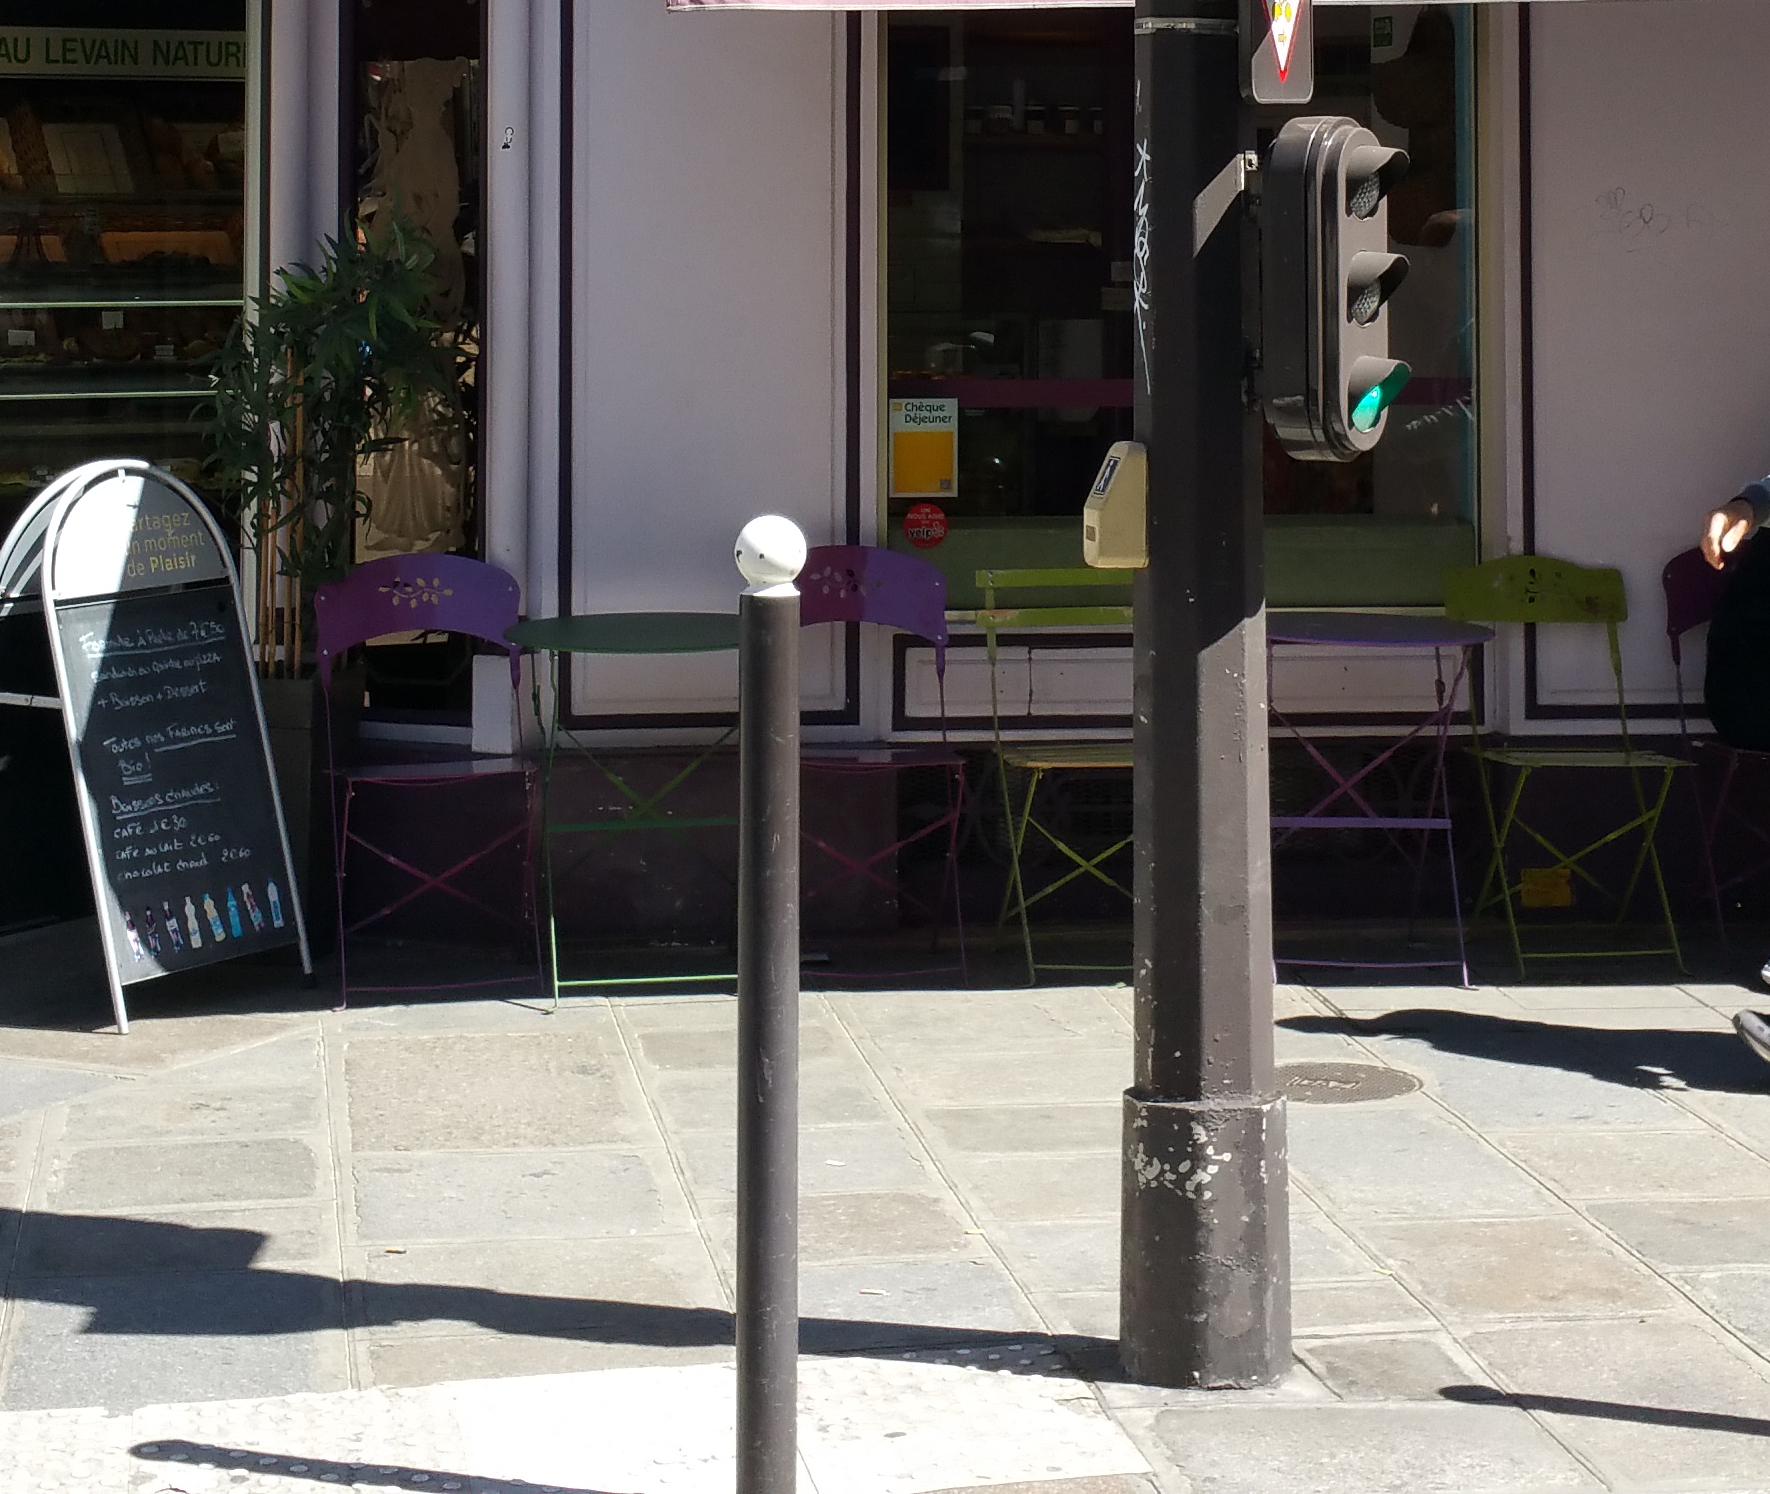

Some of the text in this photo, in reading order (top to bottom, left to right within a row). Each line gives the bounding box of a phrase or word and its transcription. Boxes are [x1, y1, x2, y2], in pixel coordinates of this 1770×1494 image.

[44, 36, 140, 66] LEVAIN
[152, 38, 245, 68] NATUR
[904, 401, 946, 414] Chèque
[904, 413, 953, 426] Déjeuner
[132, 512, 190, 532] artagez
[144, 530, 205, 552] moment
[127, 551, 197, 578] de Plaisir
